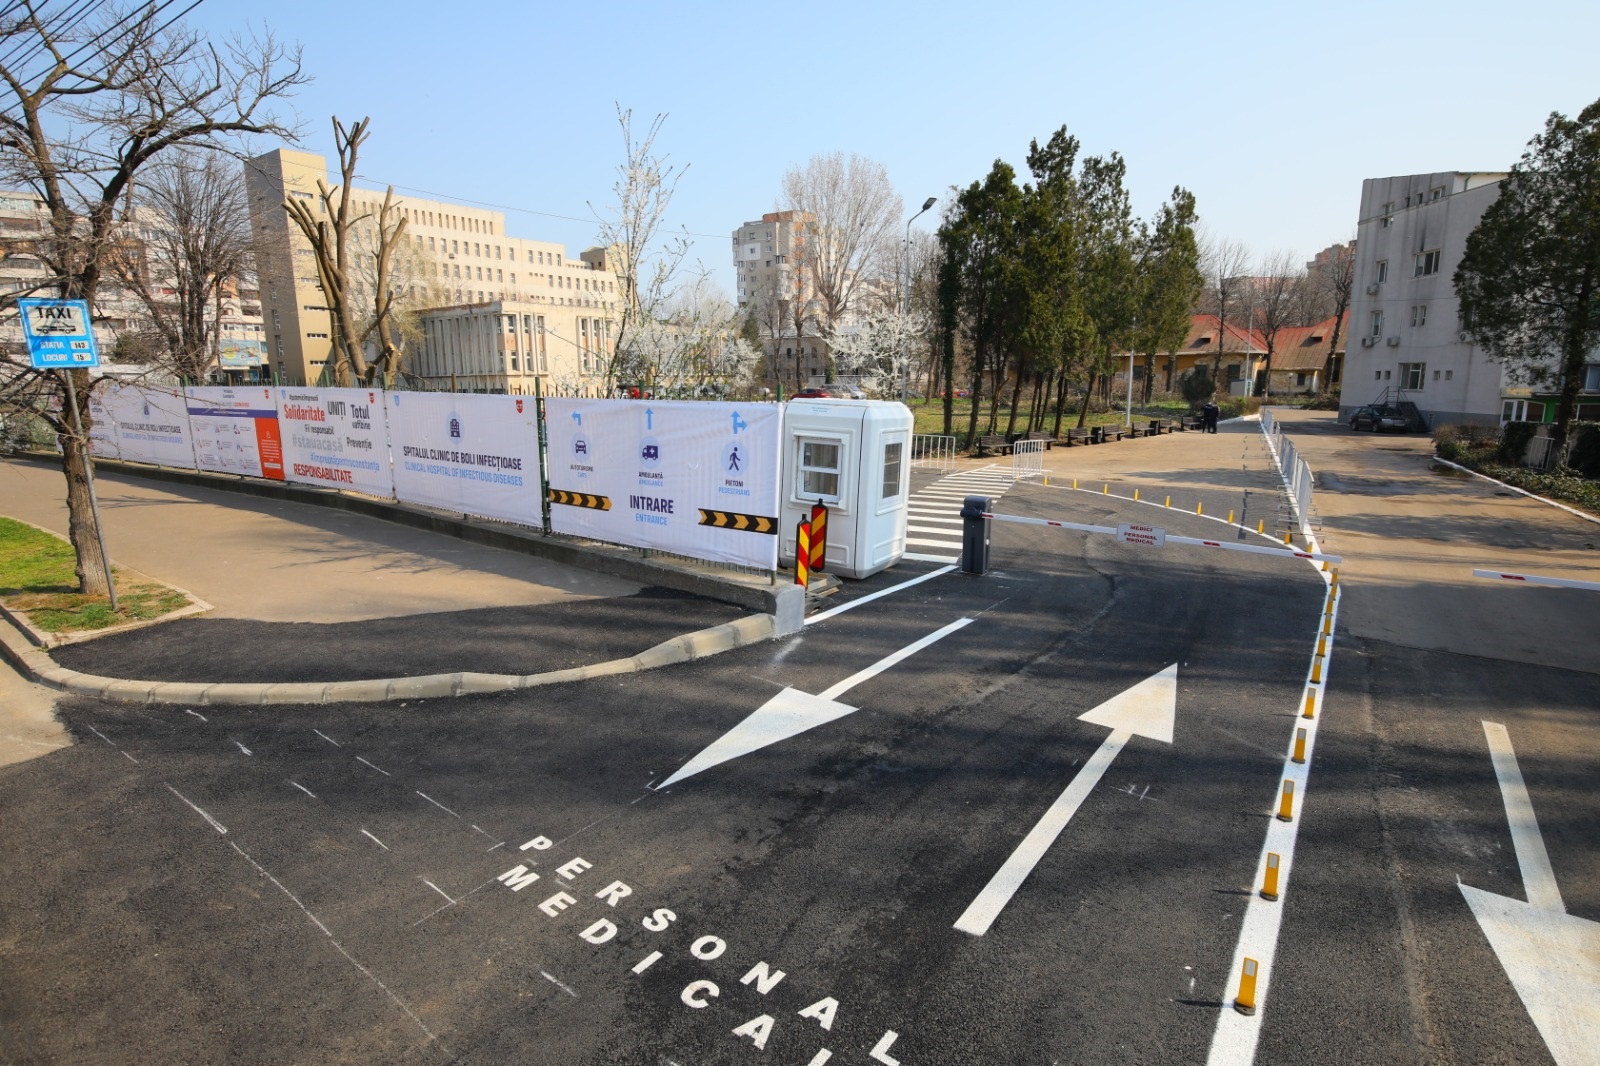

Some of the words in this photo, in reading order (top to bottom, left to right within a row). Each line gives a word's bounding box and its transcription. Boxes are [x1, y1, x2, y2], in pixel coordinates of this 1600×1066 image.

[36, 307, 71, 319] TAXI
[42, 353, 69, 361] LOCURI
[284, 403, 325, 422] Solidaritate
[327, 400, 346, 420] UNIȚI
[350, 404, 370, 420] Totul
[311, 425, 334, 436] responsabil
[403, 446, 429, 459] SPITALUL
[430, 449, 450, 462] CLINIC
[451, 451, 460, 463] DE
[460, 452, 476, 465] BOLI
[476, 454, 522, 471] INFECȚIOASE
[293, 463, 353, 483] RESPONSABILITATE
[404, 461, 426, 473] CLINICAL
[427, 464, 451, 476] HOSPITAL
[452, 467, 459, 478] OF
[460, 468, 492, 482] INFECTIOUS
[493, 473, 523, 487] DISEASES
[638, 479, 663, 487] AMBULANCE
[725, 479, 744, 488] PIETONI
[718, 486, 751, 497] PEDESTRIANS
[629, 494, 674, 514] INTRARE
[635, 512, 668, 526] ENTRANCE
[1123, 531, 1158, 541] PERSONAL
[1126, 537, 1154, 545] MEDICAL
[519, 835, 901, 1066] PERSONAL
